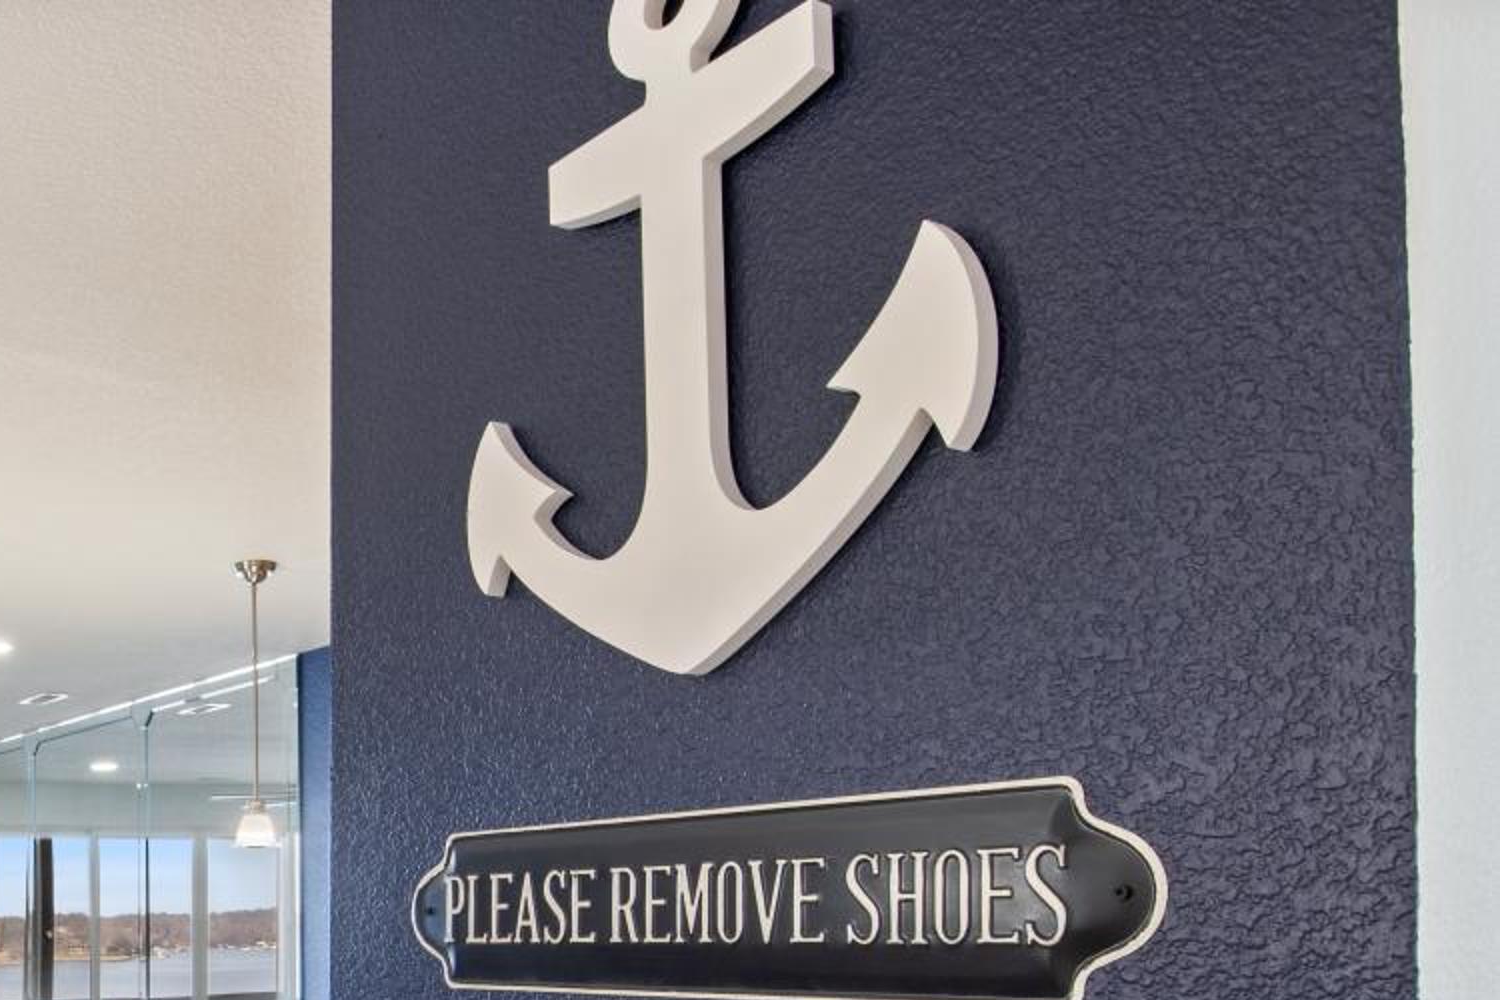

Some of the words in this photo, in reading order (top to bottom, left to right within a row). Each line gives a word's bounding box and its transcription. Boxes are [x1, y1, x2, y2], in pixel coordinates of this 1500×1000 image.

[444, 867, 595, 944] PLEASE
[610, 857, 825, 945] REMOVE
[845, 843, 1070, 947] SHOES
